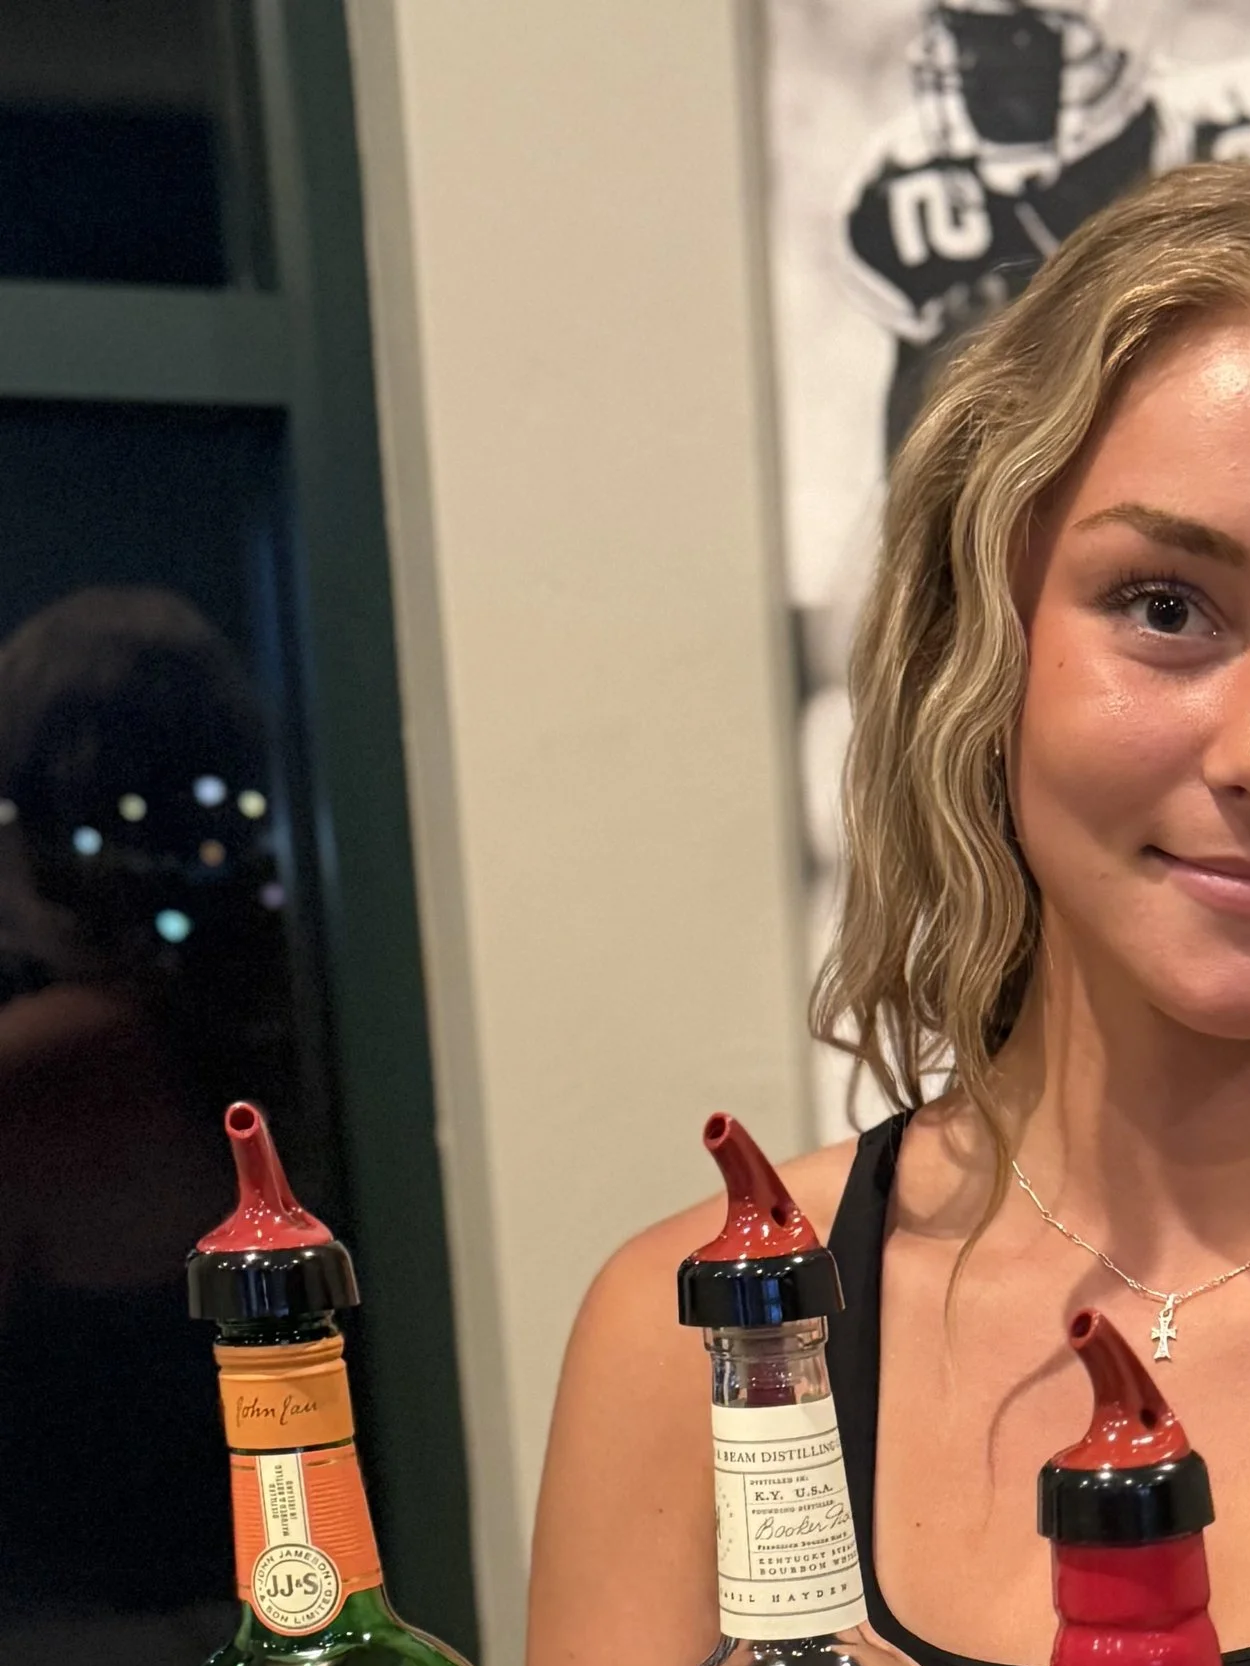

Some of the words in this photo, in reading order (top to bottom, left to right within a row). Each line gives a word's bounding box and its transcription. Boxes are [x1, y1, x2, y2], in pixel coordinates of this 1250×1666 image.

[236, 1396, 275, 1428] John
[724, 1450, 756, 1463] BEAM
[761, 1441, 835, 1463] DISTILLING
[755, 1491, 784, 1501] K.Y.
[755, 1516, 828, 1540] Booker
[257, 1555, 275, 1584] JOHN
[279, 1549, 332, 1579] JAMESON
[772, 1584, 848, 1603] HAYDEN
[266, 1606, 289, 1624] SON
[294, 1590, 334, 1625] LIMITED
